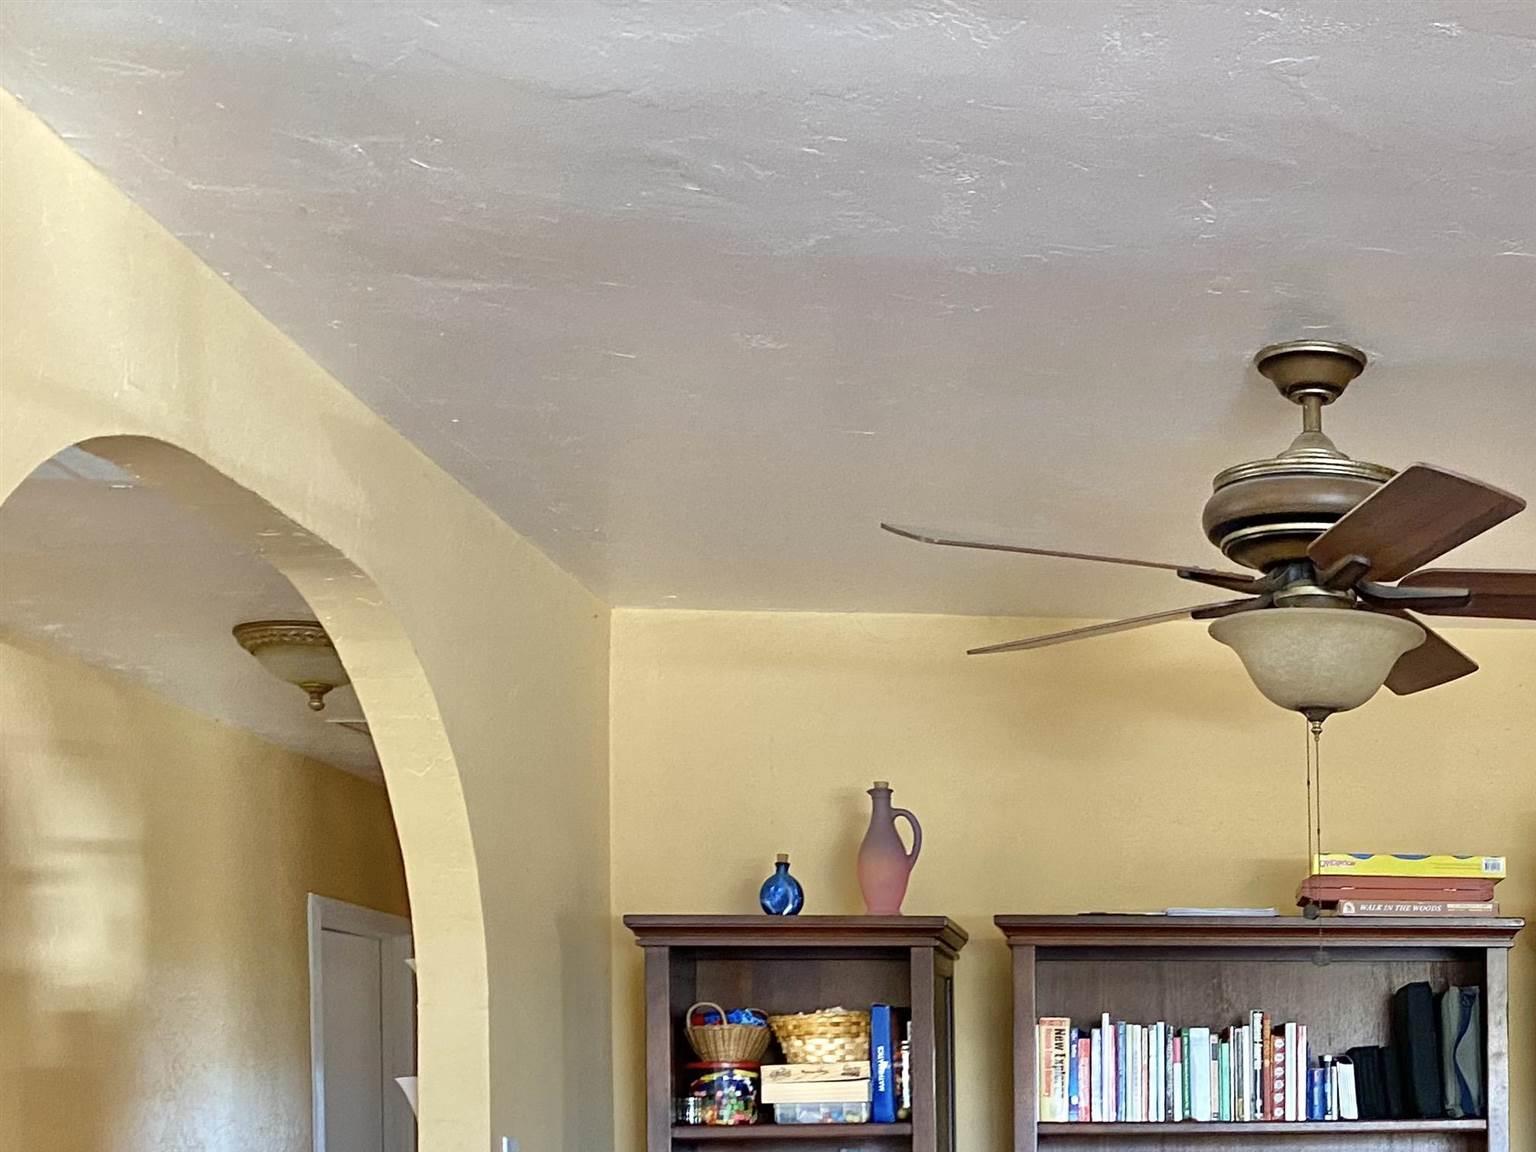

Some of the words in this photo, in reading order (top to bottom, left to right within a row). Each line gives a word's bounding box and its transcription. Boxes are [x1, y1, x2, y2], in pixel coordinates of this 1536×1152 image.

[1359, 904, 1381, 912] WALK
[1383, 904, 1393, 912] IN
[1395, 904, 1411, 912] THE
[1412, 904, 1442, 912] WOODS
[1054, 1028, 1066, 1051] New
